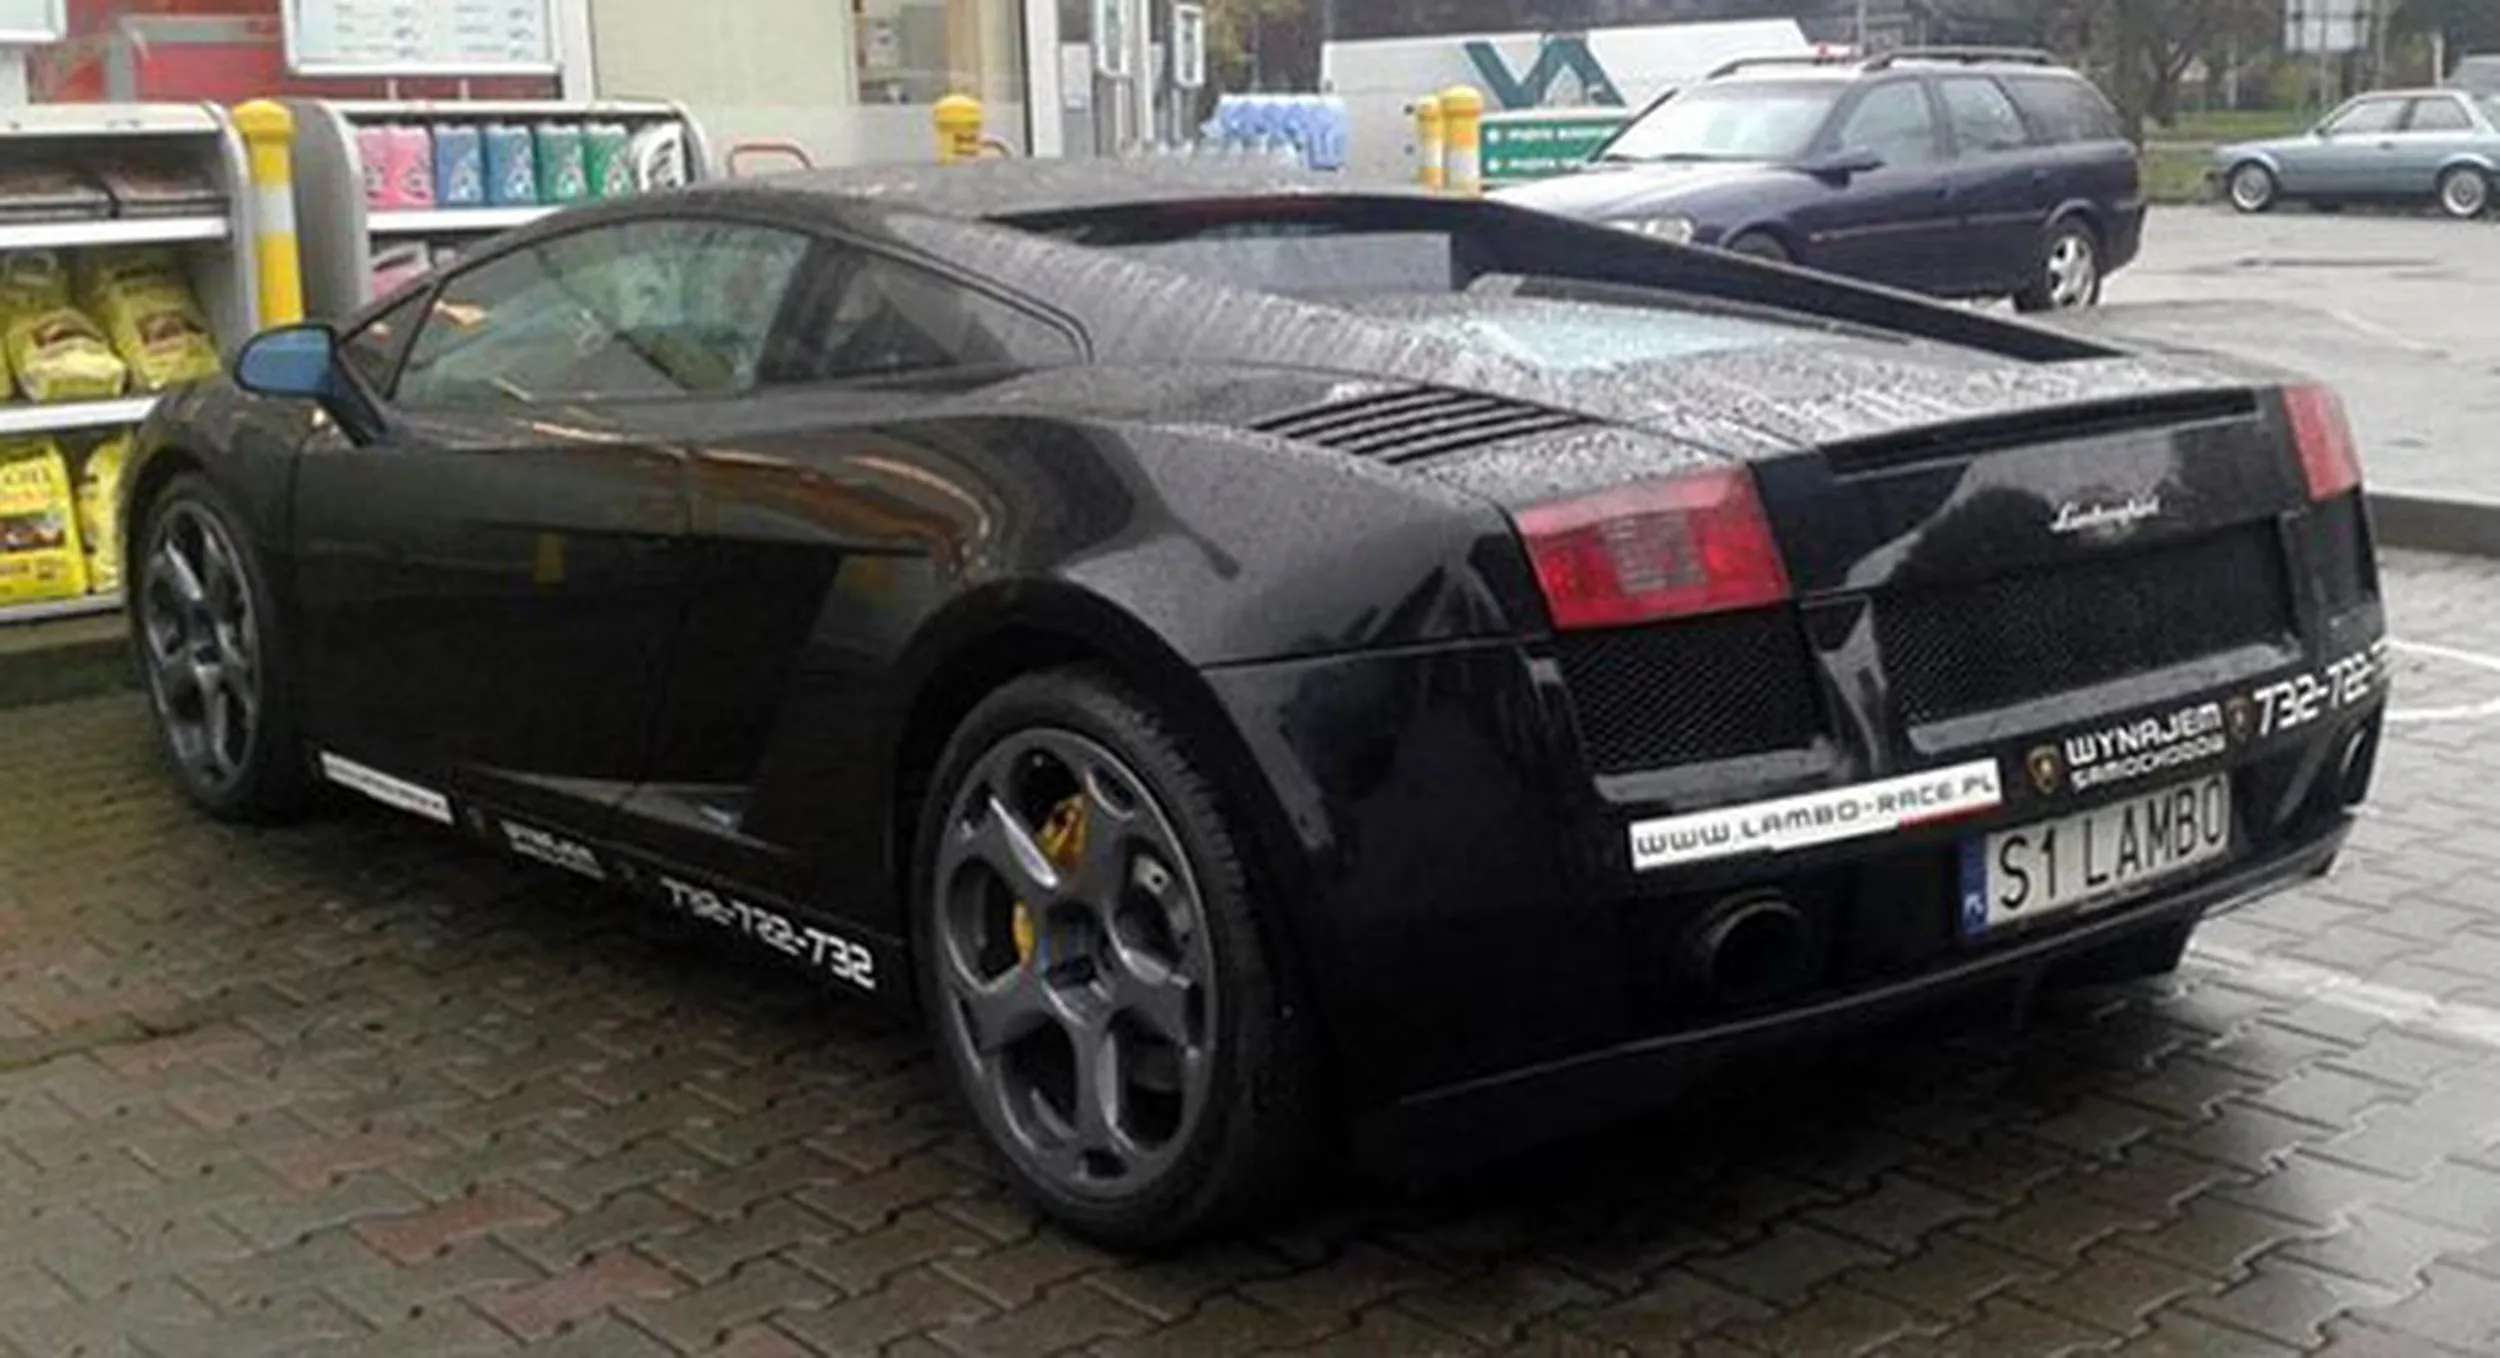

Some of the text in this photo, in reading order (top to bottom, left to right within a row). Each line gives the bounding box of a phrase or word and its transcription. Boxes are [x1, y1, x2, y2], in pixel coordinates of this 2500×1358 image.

[2065, 702, 2222, 766] WYNAJEM
[1636, 771, 1993, 856] WWW.LAMBO-RACE.PL
[2001, 776, 2223, 909] S1 LAMBO
